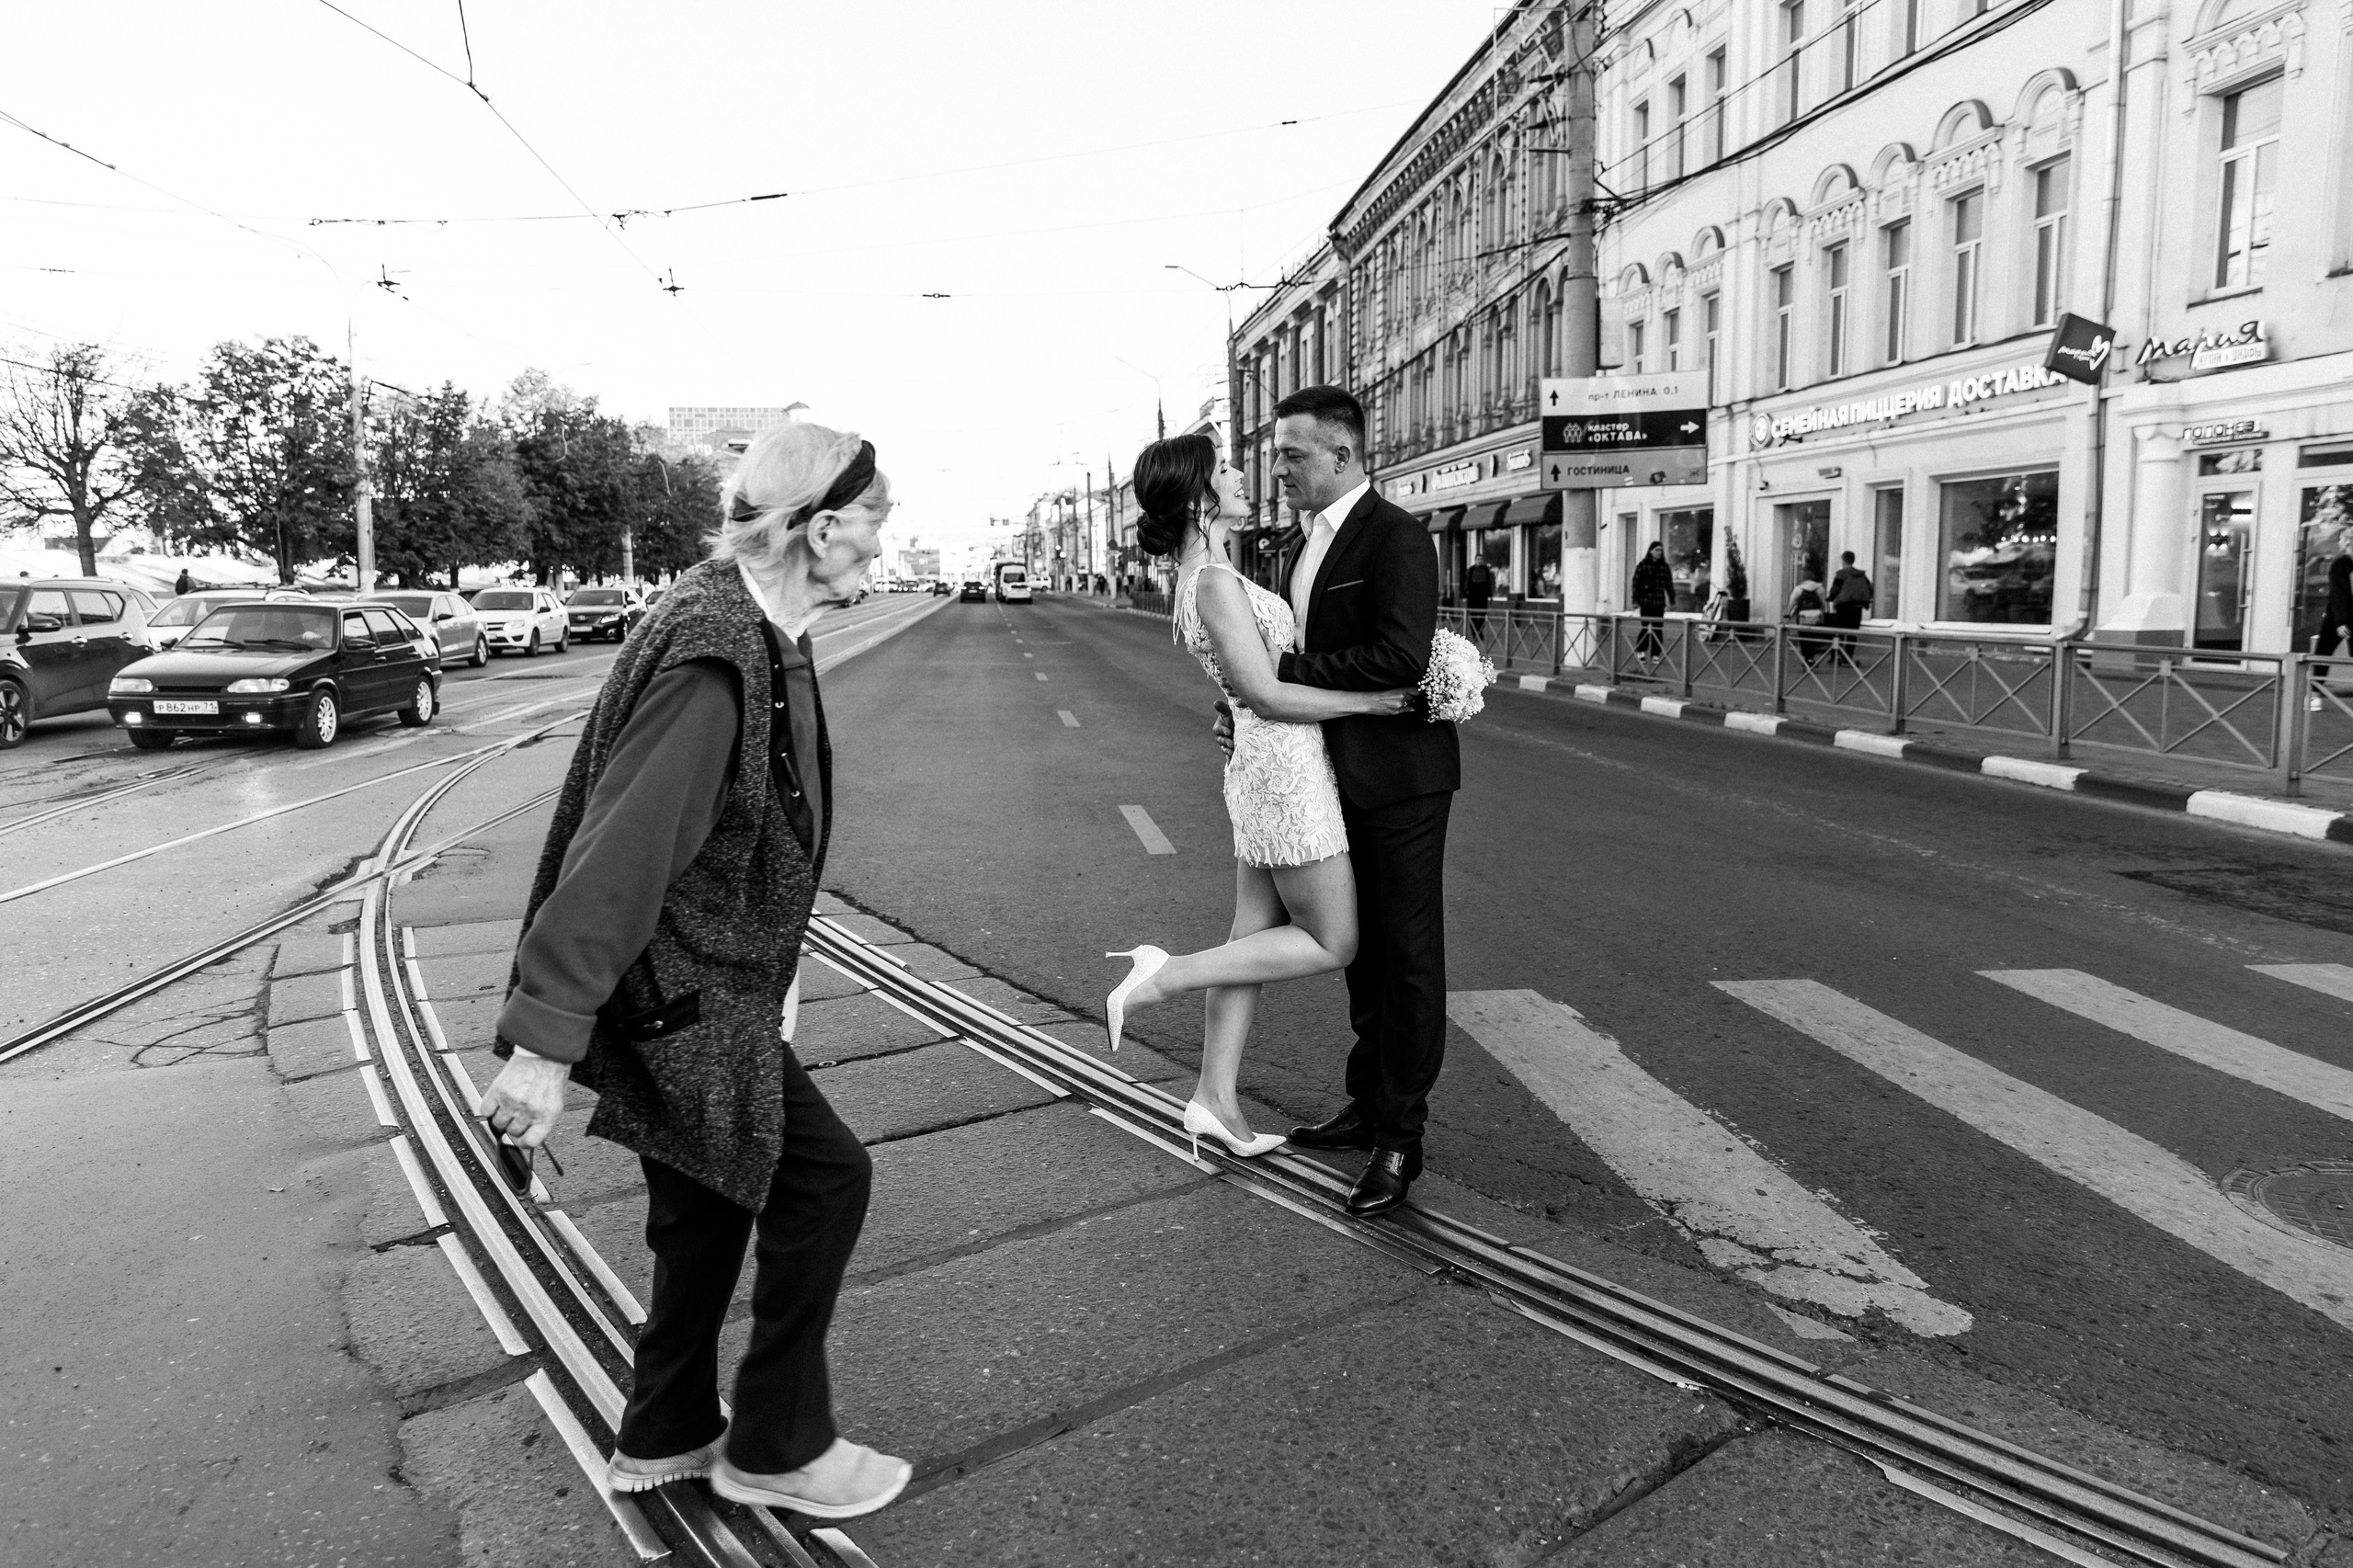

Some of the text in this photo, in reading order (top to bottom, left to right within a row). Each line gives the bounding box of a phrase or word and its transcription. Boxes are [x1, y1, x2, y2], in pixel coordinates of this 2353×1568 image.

[1613, 387, 1657, 399] ЛЕНИНА
[1771, 364, 2068, 438] СЕМЕЙНАЯ ПИЦЦЕРИЯ ДОСТАВКА
[1588, 423, 1630, 432] кластер
[1588, 430, 1648, 443] «ОКТАВА»
[1567, 464, 1631, 476] ГОСТИНИЦА
